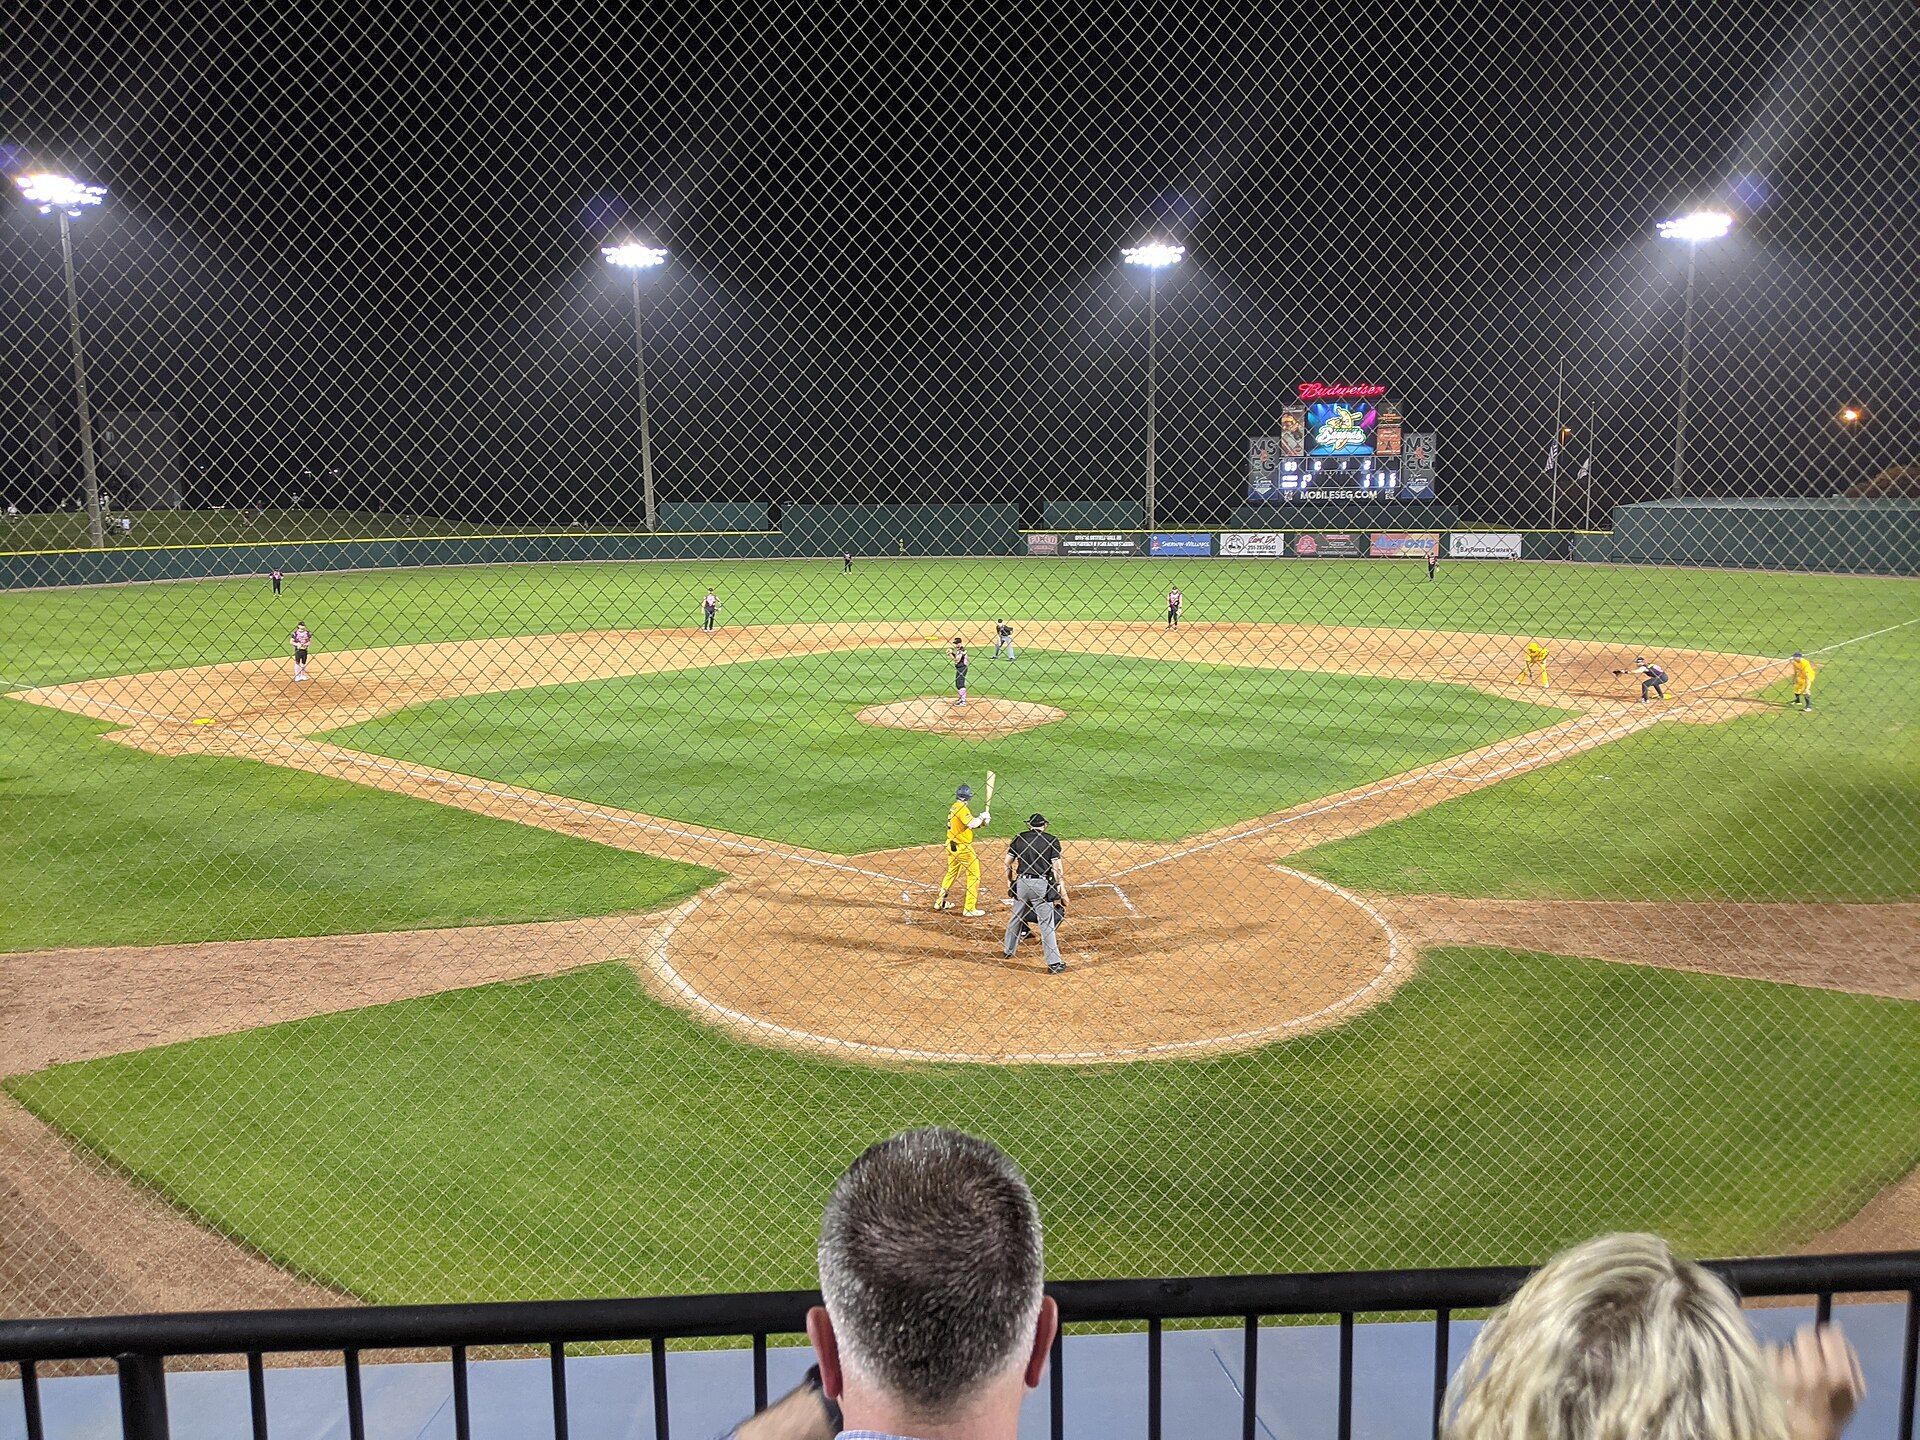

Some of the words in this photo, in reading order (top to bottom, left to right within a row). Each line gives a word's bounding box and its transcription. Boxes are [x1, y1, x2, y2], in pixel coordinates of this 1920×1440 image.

[1298, 382, 1386, 399] Budweiser
[1250, 439, 1276, 456] MS
[1405, 436, 1433, 453] MS
[1300, 490, 1377, 500] MOBILESEG.COM
[1375, 535, 1434, 549] Aaron's
